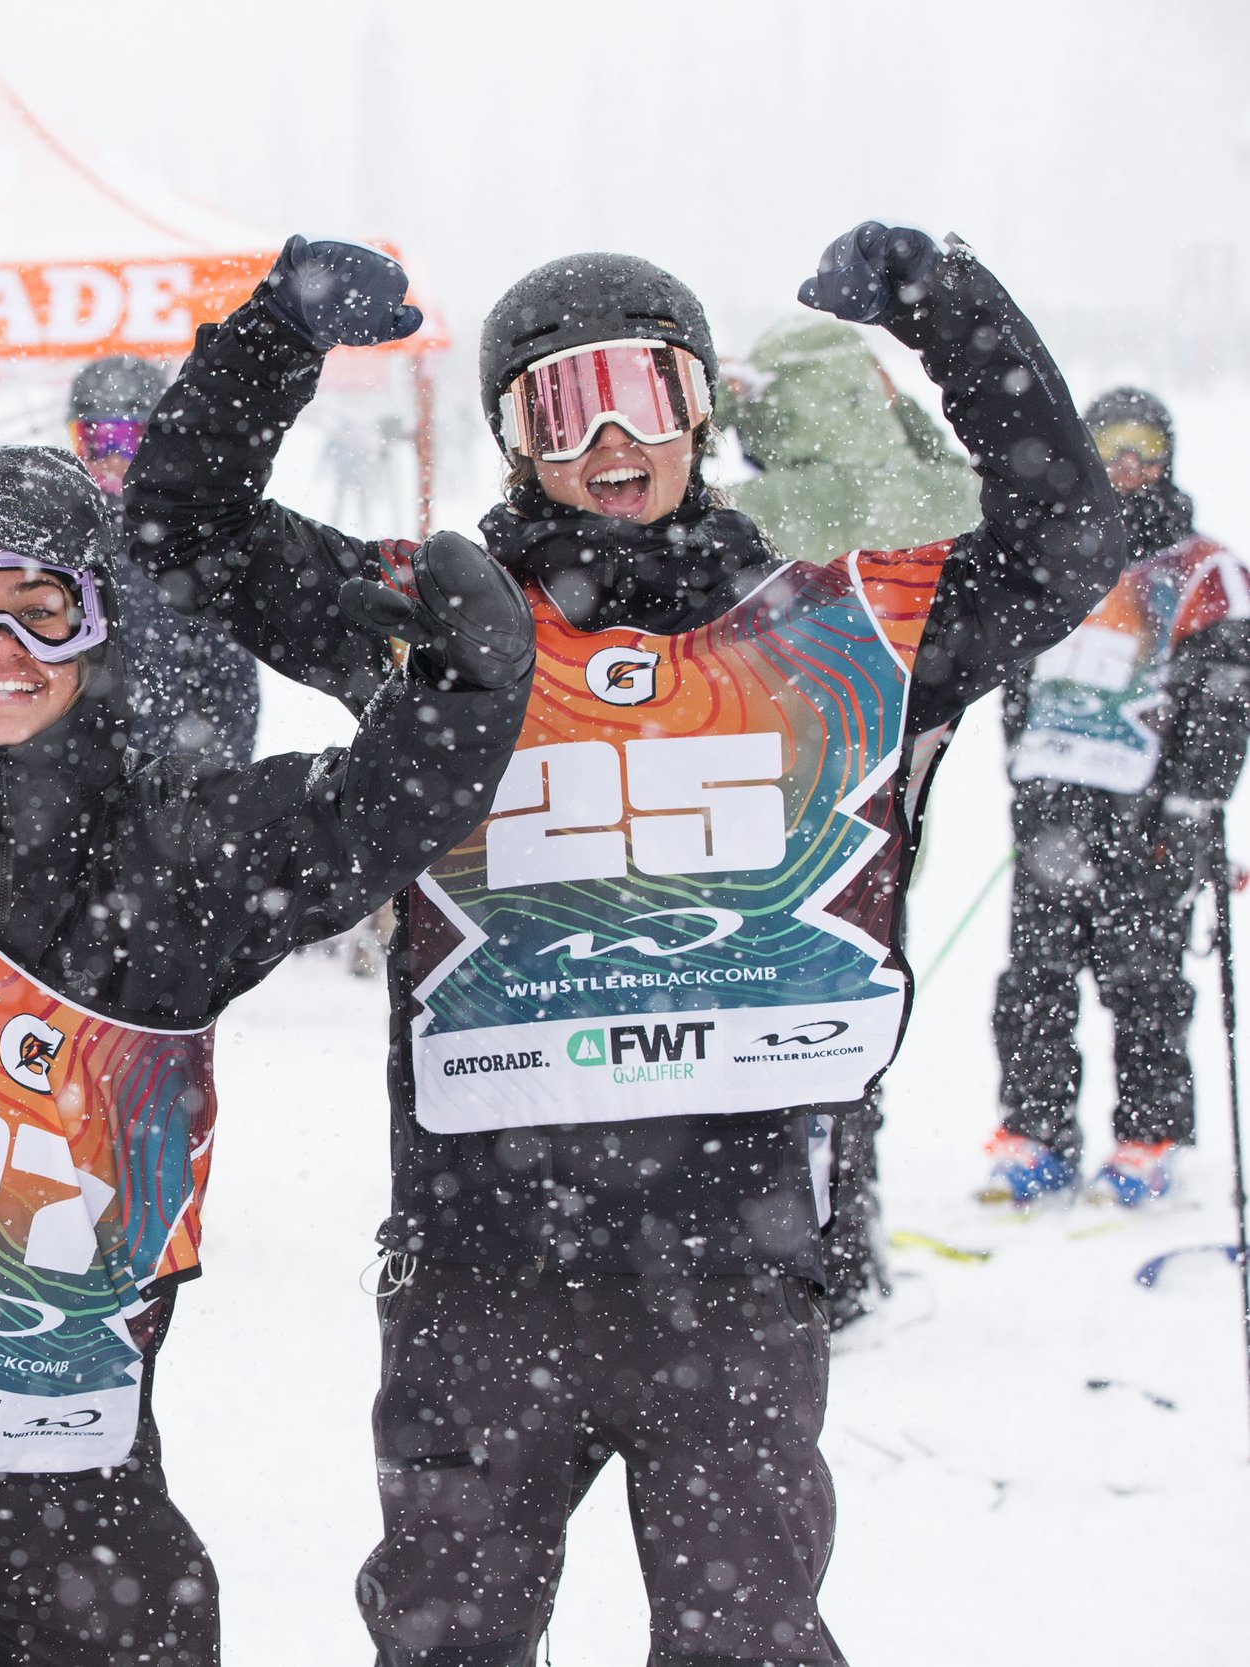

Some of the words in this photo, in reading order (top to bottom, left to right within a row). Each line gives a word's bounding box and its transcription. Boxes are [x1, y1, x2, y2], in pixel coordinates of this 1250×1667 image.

[486, 731, 787, 891] 25
[610, 1021, 715, 1065] FWT
[613, 1063, 694, 1084] QUALIFIER
